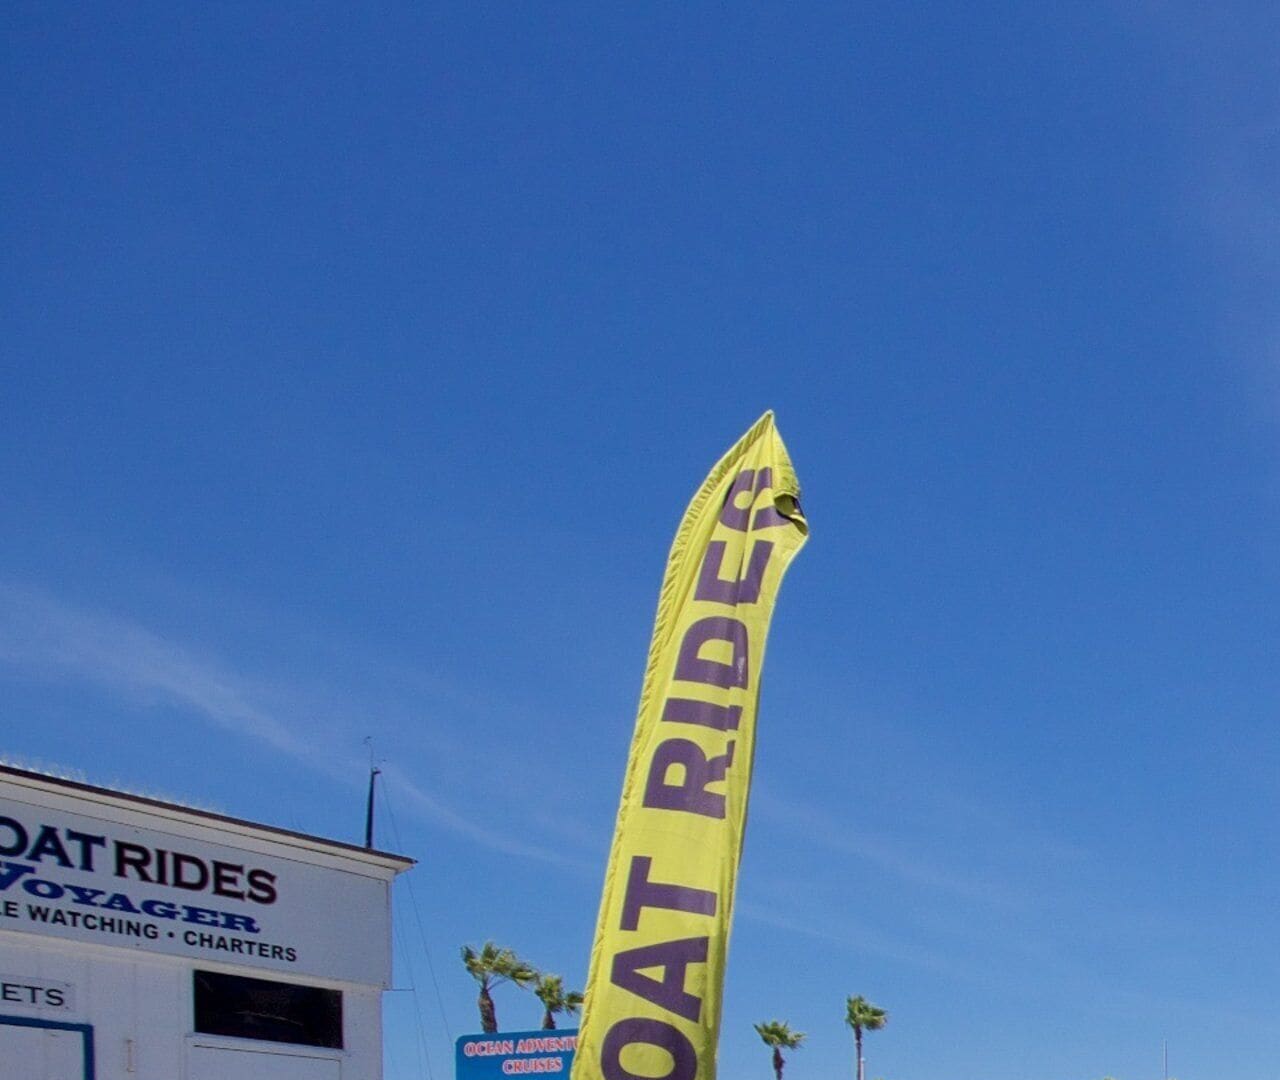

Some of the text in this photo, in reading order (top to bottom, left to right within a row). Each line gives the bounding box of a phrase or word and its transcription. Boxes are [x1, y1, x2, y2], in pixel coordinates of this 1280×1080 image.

[642, 466, 793, 820] RIDES
[114, 840, 278, 905] RIDES
[27, 904, 159, 939] WATCHING
[184, 930, 297, 962] CHARTERS
[463, 1041, 514, 1058] OCEAN
[502, 1057, 563, 1076] CRUISES
